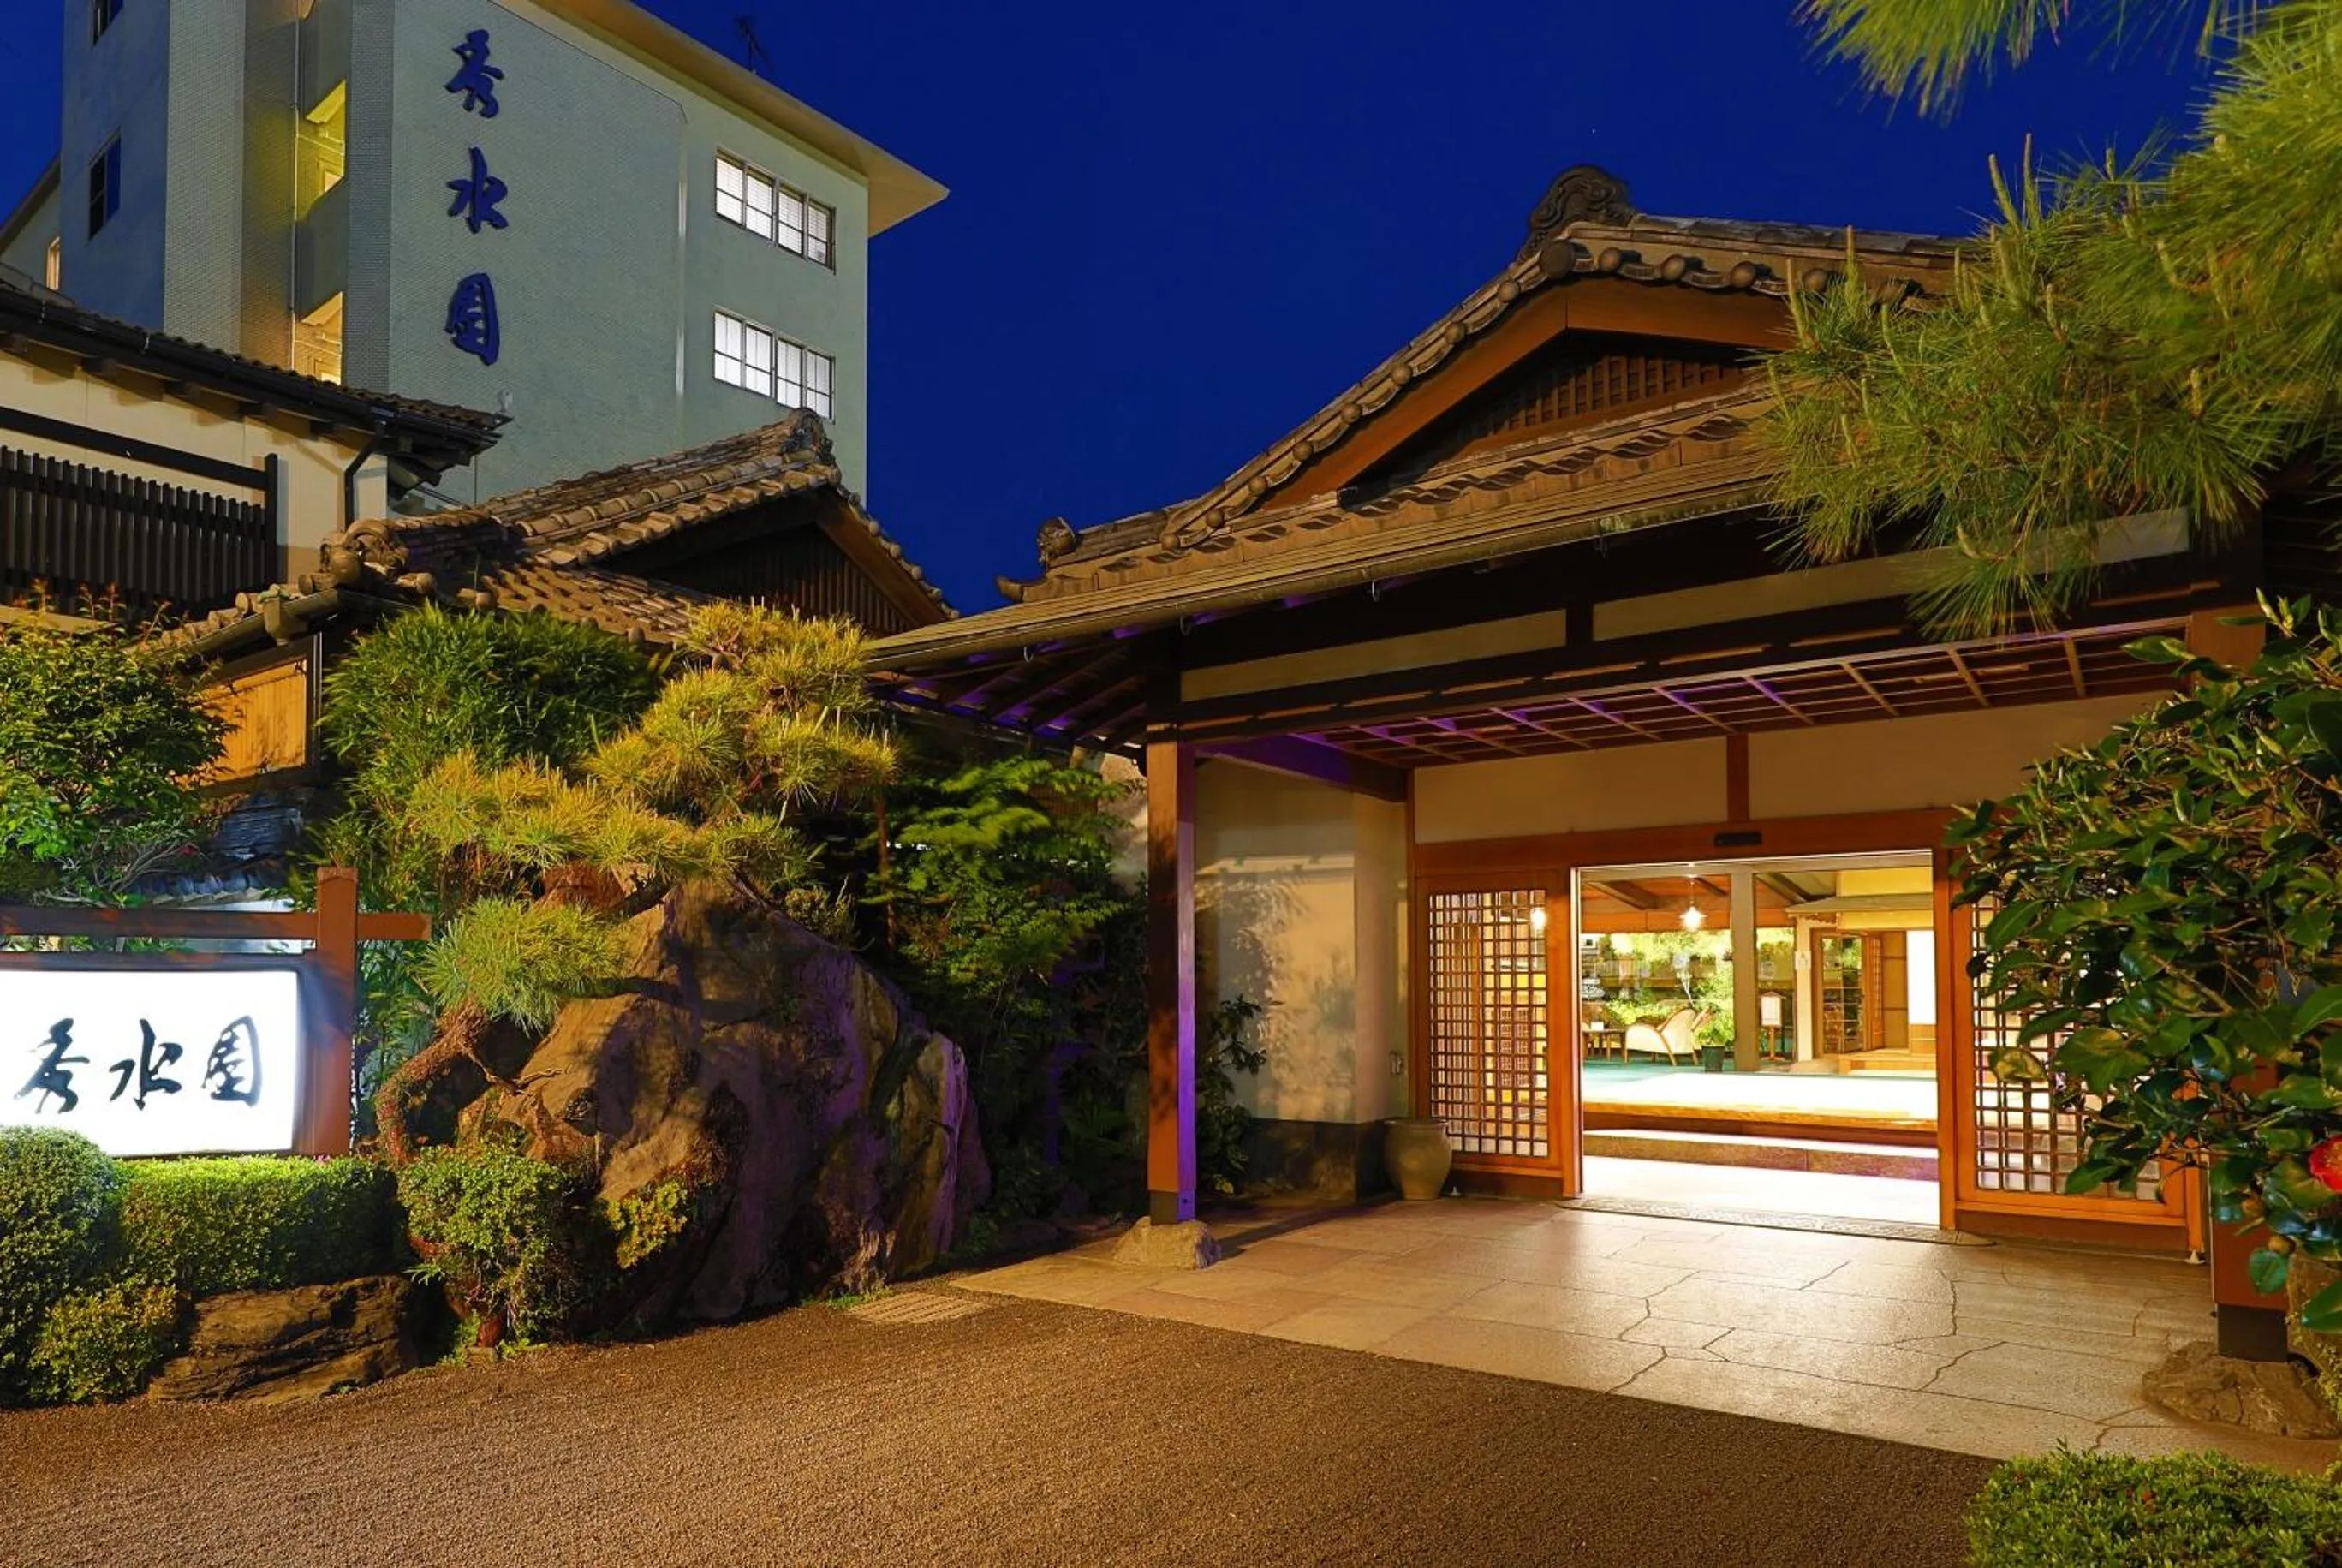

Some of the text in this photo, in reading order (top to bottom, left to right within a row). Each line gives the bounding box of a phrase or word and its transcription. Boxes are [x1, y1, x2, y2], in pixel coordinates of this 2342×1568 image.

[444, 28, 510, 367] 秀水園
[13, 1014, 263, 1114] 秀水園
